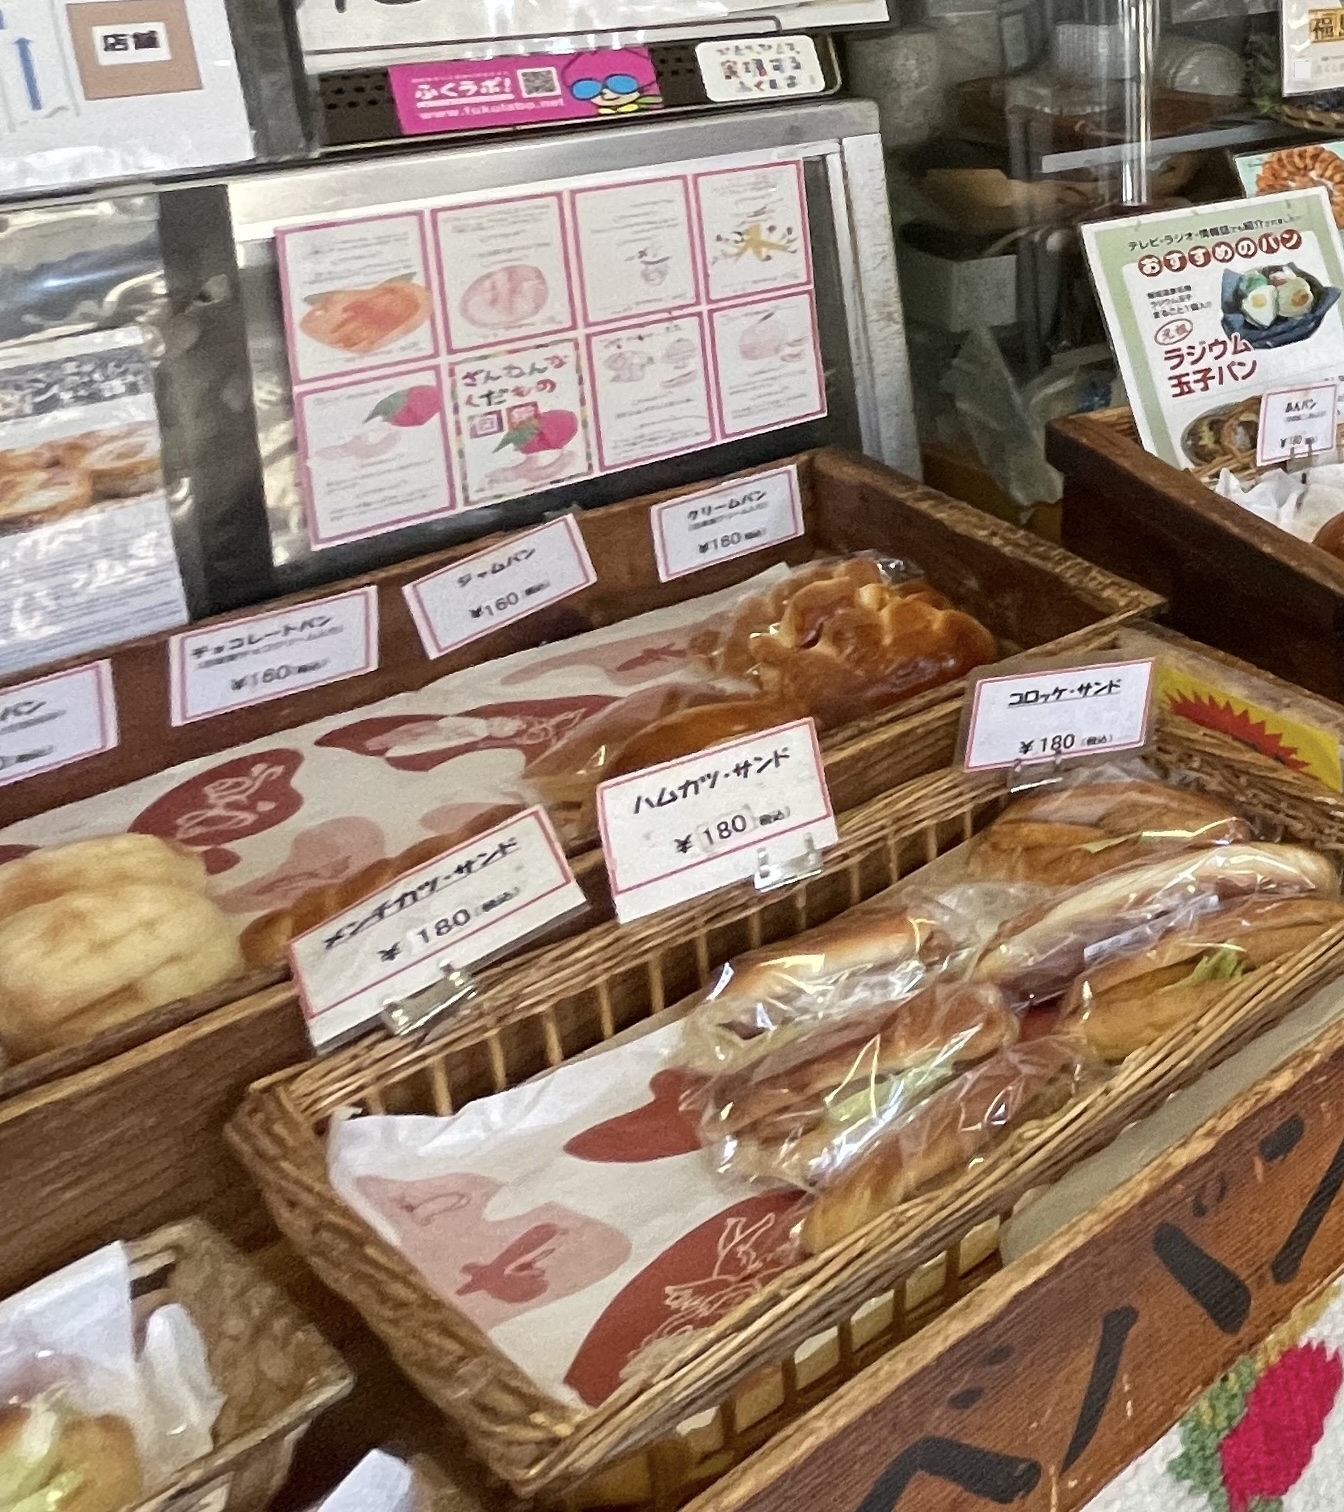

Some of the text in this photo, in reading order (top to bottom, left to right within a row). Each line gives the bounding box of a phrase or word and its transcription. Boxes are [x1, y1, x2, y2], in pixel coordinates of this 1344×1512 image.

[1137, 228, 1303, 278] おすすめのパン
[1163, 331, 1254, 371] ラジウム
[1167, 359, 1258, 399] 玉子パン
[191, 614, 334, 660] チョコレートパン
[1007, 677, 1122, 708] コロッケ・サンド
